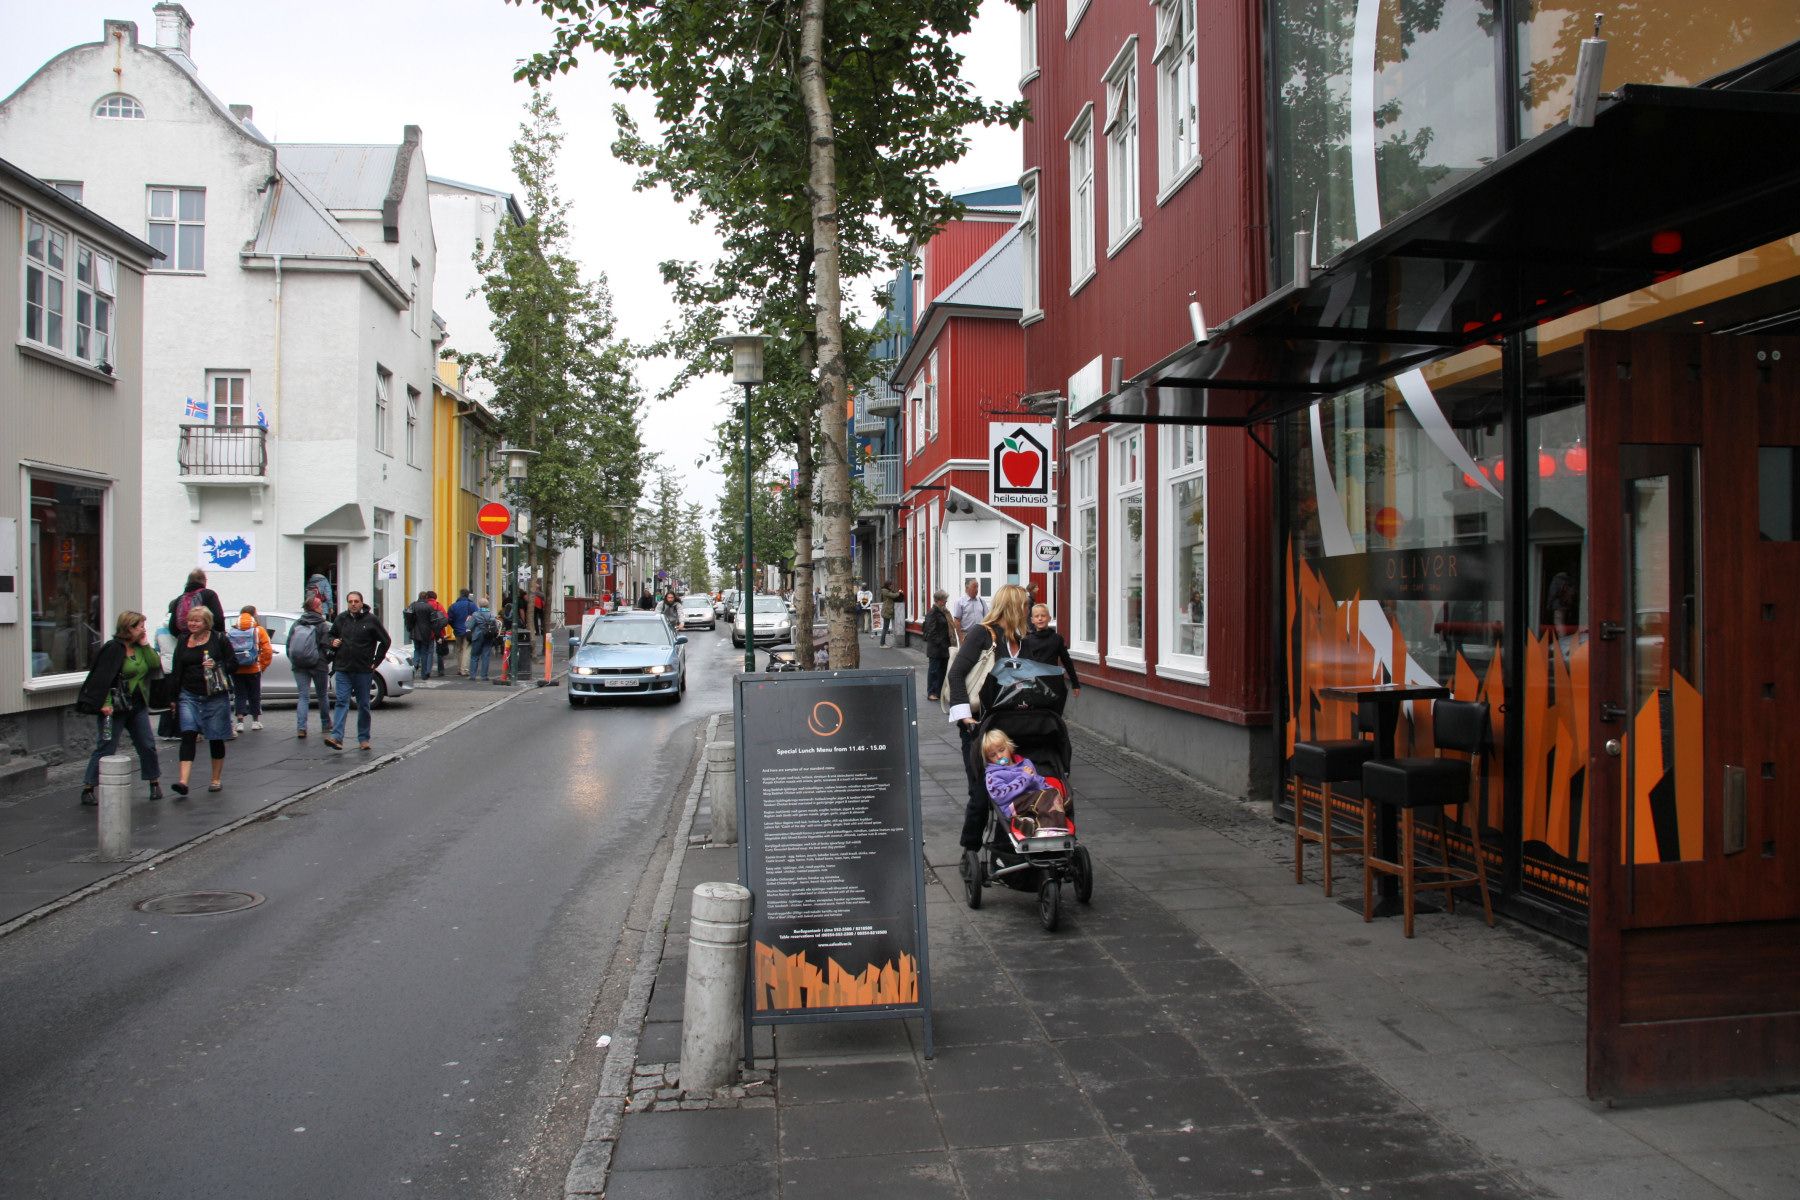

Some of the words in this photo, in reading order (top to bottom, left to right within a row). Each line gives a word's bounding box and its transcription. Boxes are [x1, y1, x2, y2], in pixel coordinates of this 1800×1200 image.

[776, 748, 798, 756] Special
[798, 747, 816, 755] Lunch
[816, 746, 833, 754] Menu
